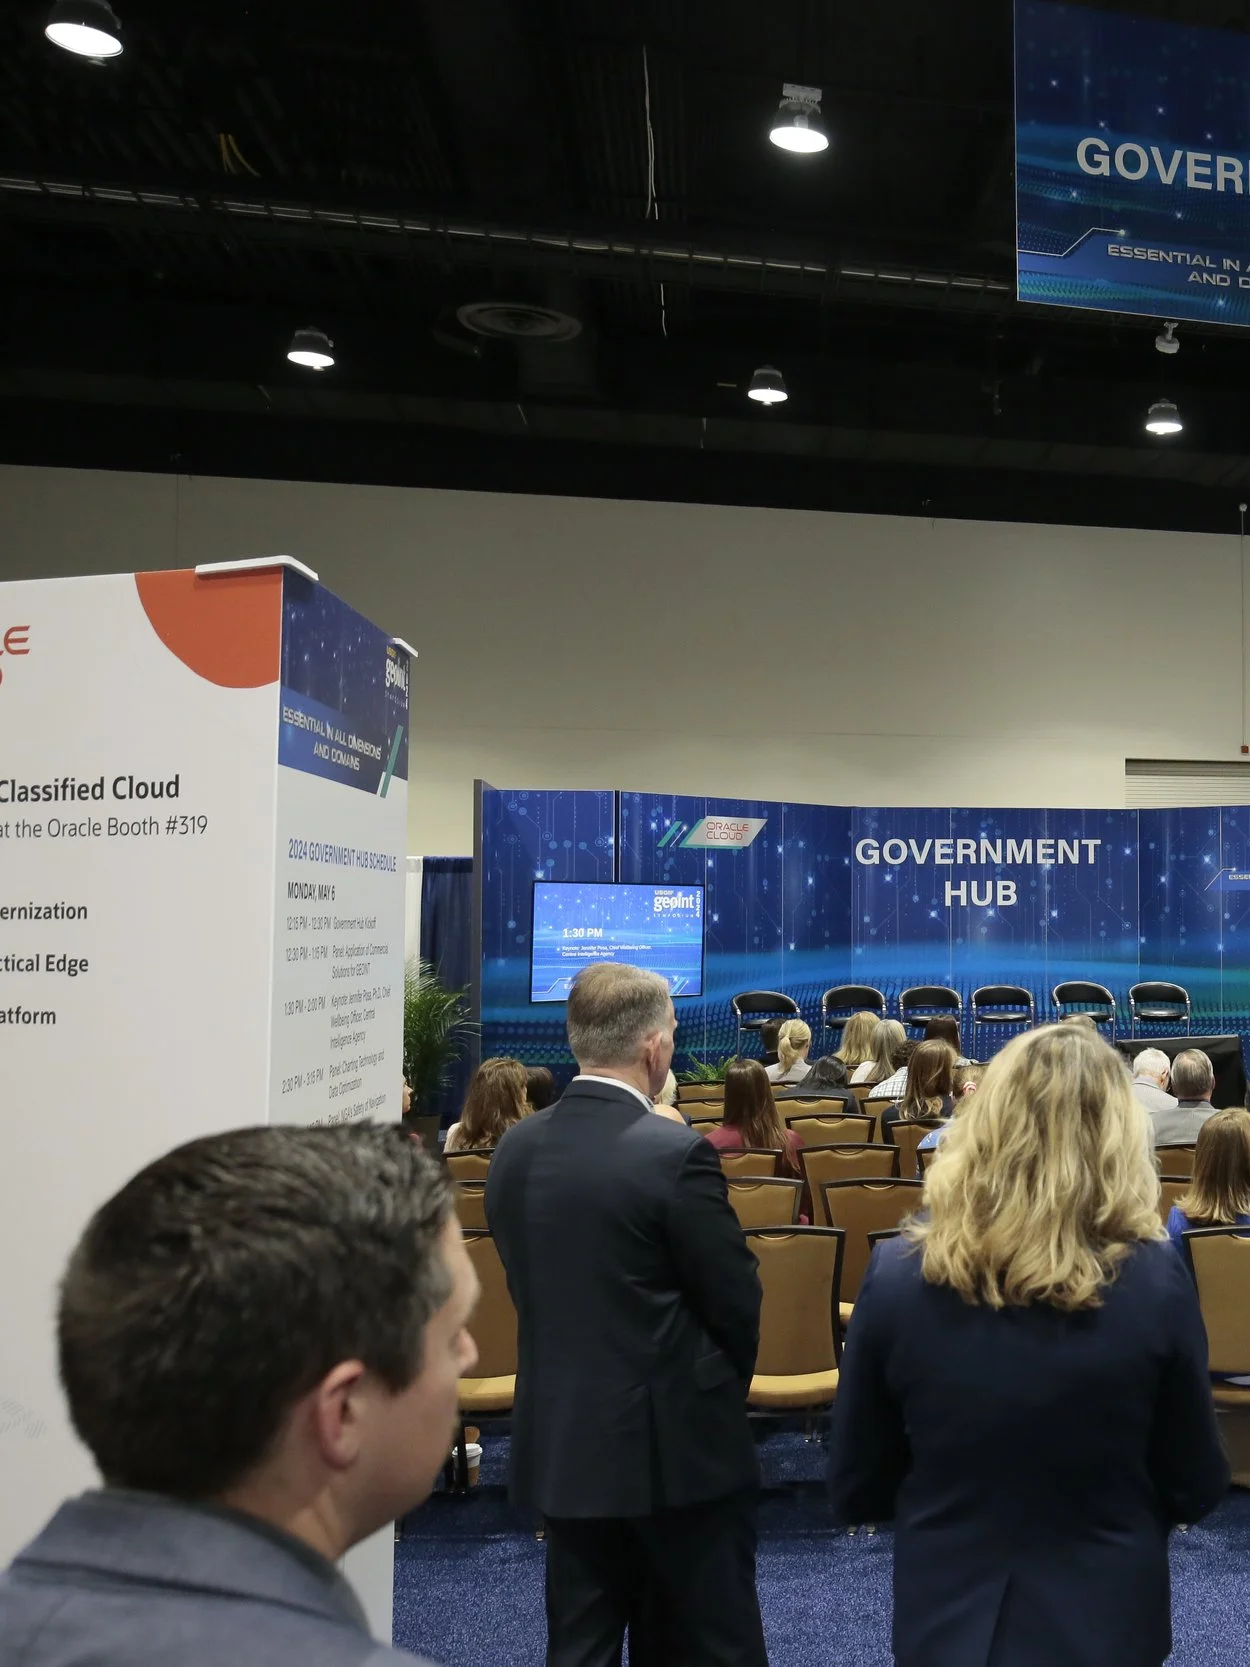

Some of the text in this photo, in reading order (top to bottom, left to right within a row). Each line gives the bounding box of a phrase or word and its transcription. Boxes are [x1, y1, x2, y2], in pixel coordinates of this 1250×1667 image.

[1108, 244, 1216, 268] ESSENTIAL
[1222, 258, 1240, 272] IN
[1188, 272, 1230, 286] AND
[283, 706, 381, 760] ESSENTIAL IN ALL DIMENSIONS
[313, 742, 360, 771] AND DOMAINS
[0, 774, 180, 803] Classified Cloud
[16, 819, 42, 838] the
[48, 817, 102, 838] Oracle
[108, 816, 159, 837] Booth
[166, 815, 208, 835] #319
[706, 822, 749, 832] ORACLE
[706, 831, 743, 840] CLOUD
[288, 838, 397, 872] 2024 GOVERNMENT HUB SCHEDULE
[855, 838, 1102, 865] GOVERNMENT
[288, 881, 336, 902] MONDAY, MAY 6
[944, 880, 1018, 906] HUB
[0, 901, 88, 920] ernization
[300, 916, 308, 930] PM
[324, 916, 331, 930] PM
[334, 916, 356, 930] Government
[562, 928, 603, 938] 1:30 PM
[286, 947, 298, 962] 12:30
[300, 946, 308, 961] PM
[320, 945, 328, 959] PM
[346, 944, 365, 958] Application
[370, 943, 389, 955] Commercial
[45, 954, 89, 977] Edge
[332, 965, 350, 979] Solutions
[284, 1001, 294, 1016] 1:30
[295, 1000, 303, 1014] PM
[319, 996, 326, 1010] PM
[349, 990, 362, 1004] Jennifer
[382, 985, 391, 998] Chief
[363, 1008, 375, 1020] Central
[330, 1031, 366, 1050] Intelligence Agency
[282, 1077, 294, 1094] 2:30
[295, 1074, 303, 1089] PM
[317, 1067, 324, 1081] PM
[342, 1060, 358, 1074] Charting
[359, 1053, 377, 1068] Technology
[329, 1078, 362, 1099] Data Optimization
[354, 1102, 364, 1116] Safety
[369, 1094, 386, 1109] Navigation
